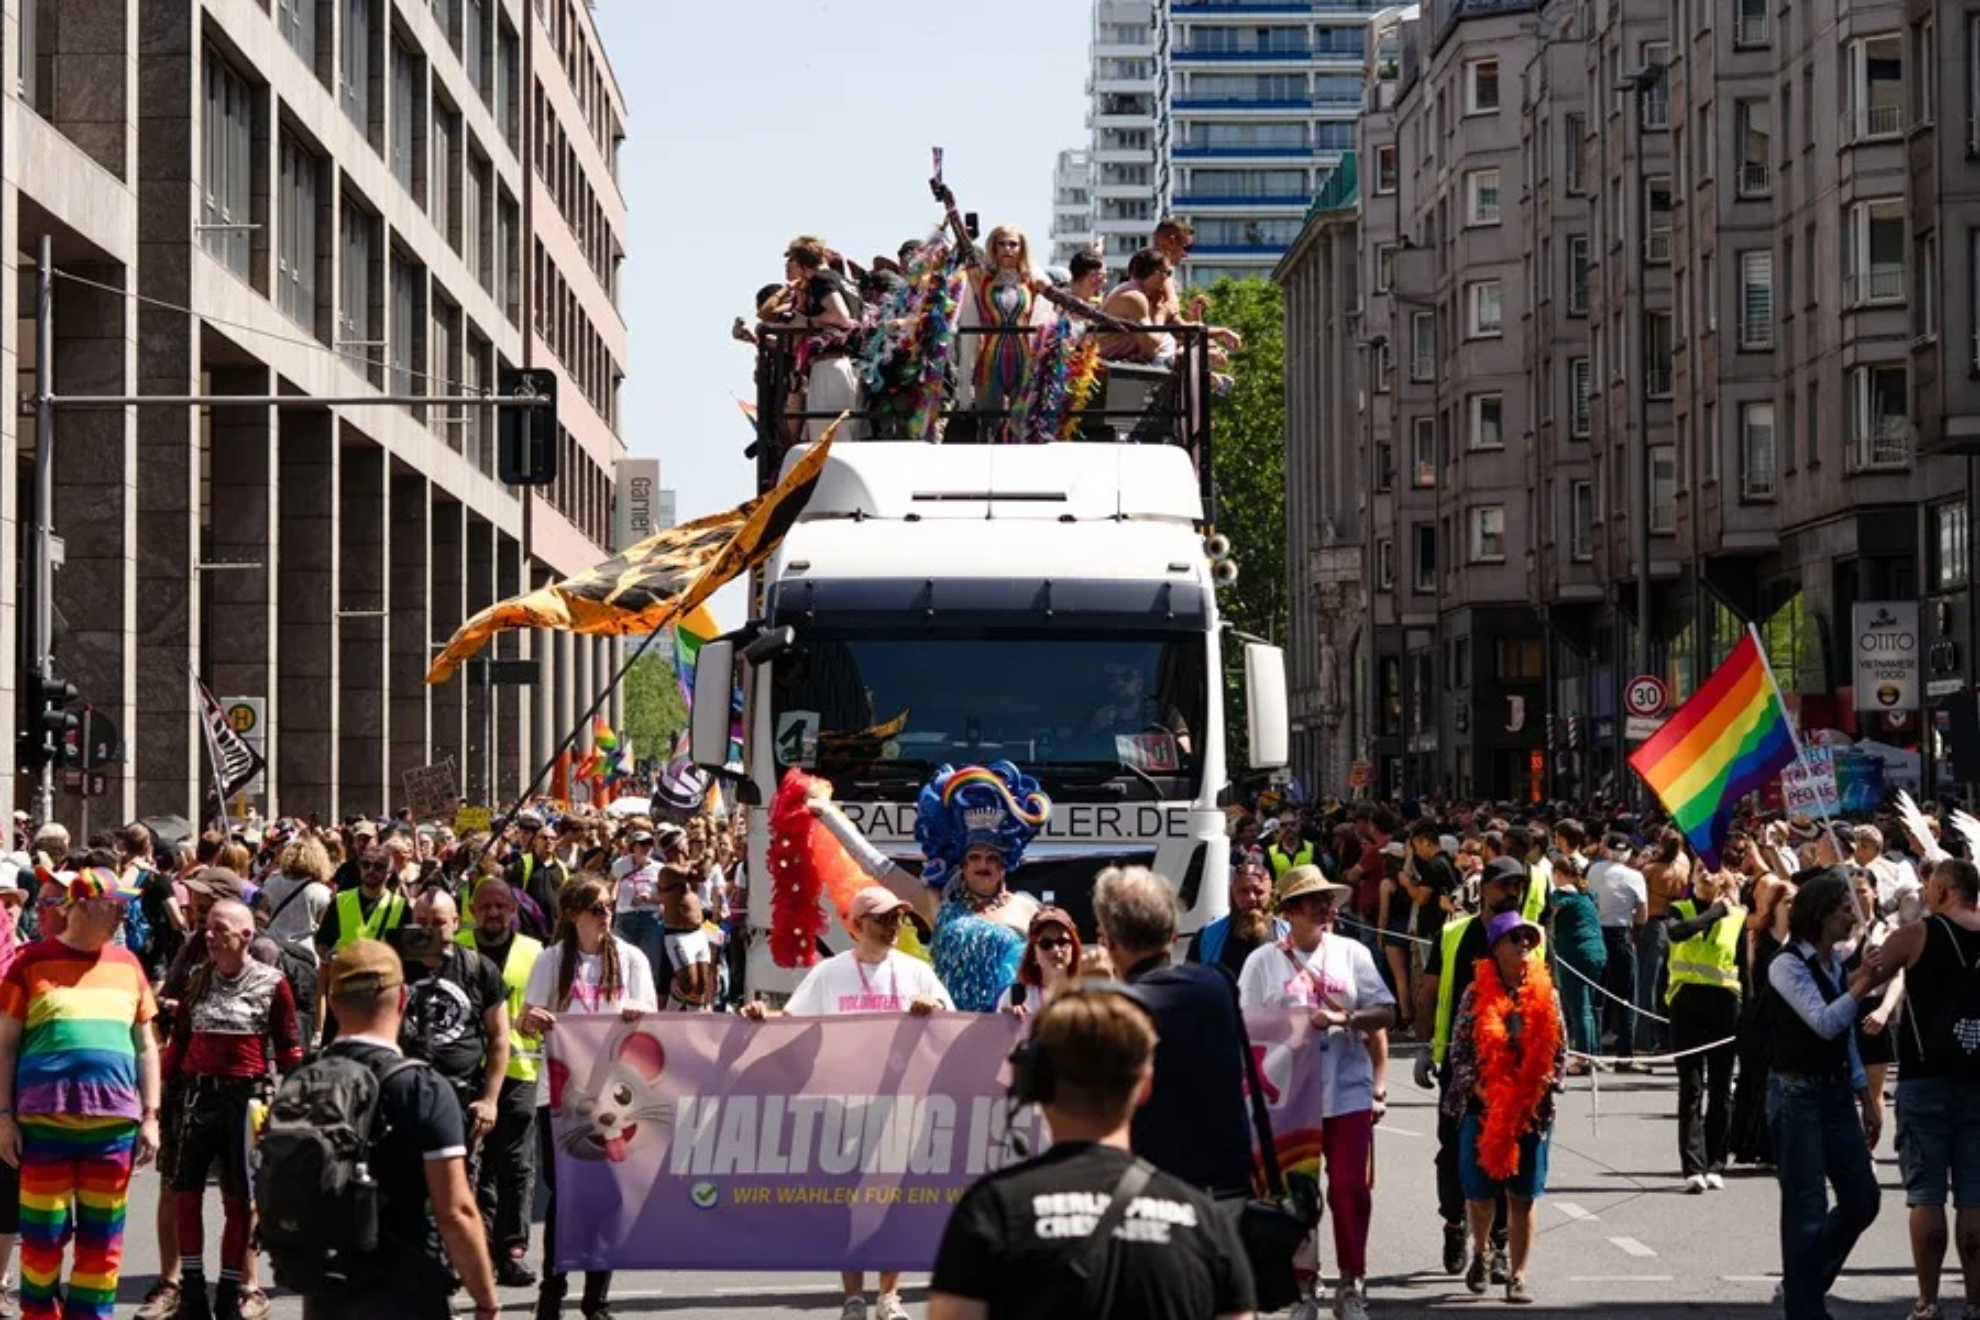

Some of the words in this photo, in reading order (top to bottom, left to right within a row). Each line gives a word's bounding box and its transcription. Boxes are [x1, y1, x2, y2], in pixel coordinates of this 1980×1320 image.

[631, 477, 652, 537] Garner
[1860, 633, 1915, 651] OTITO
[1875, 671, 1906, 680] FOOD
[1634, 687, 1657, 706] 30
[235, 710, 249, 728] H
[669, 1095, 957, 1175] HALTUNG
[734, 1187, 771, 1204] WIR
[907, 1187, 940, 1204] EIN
